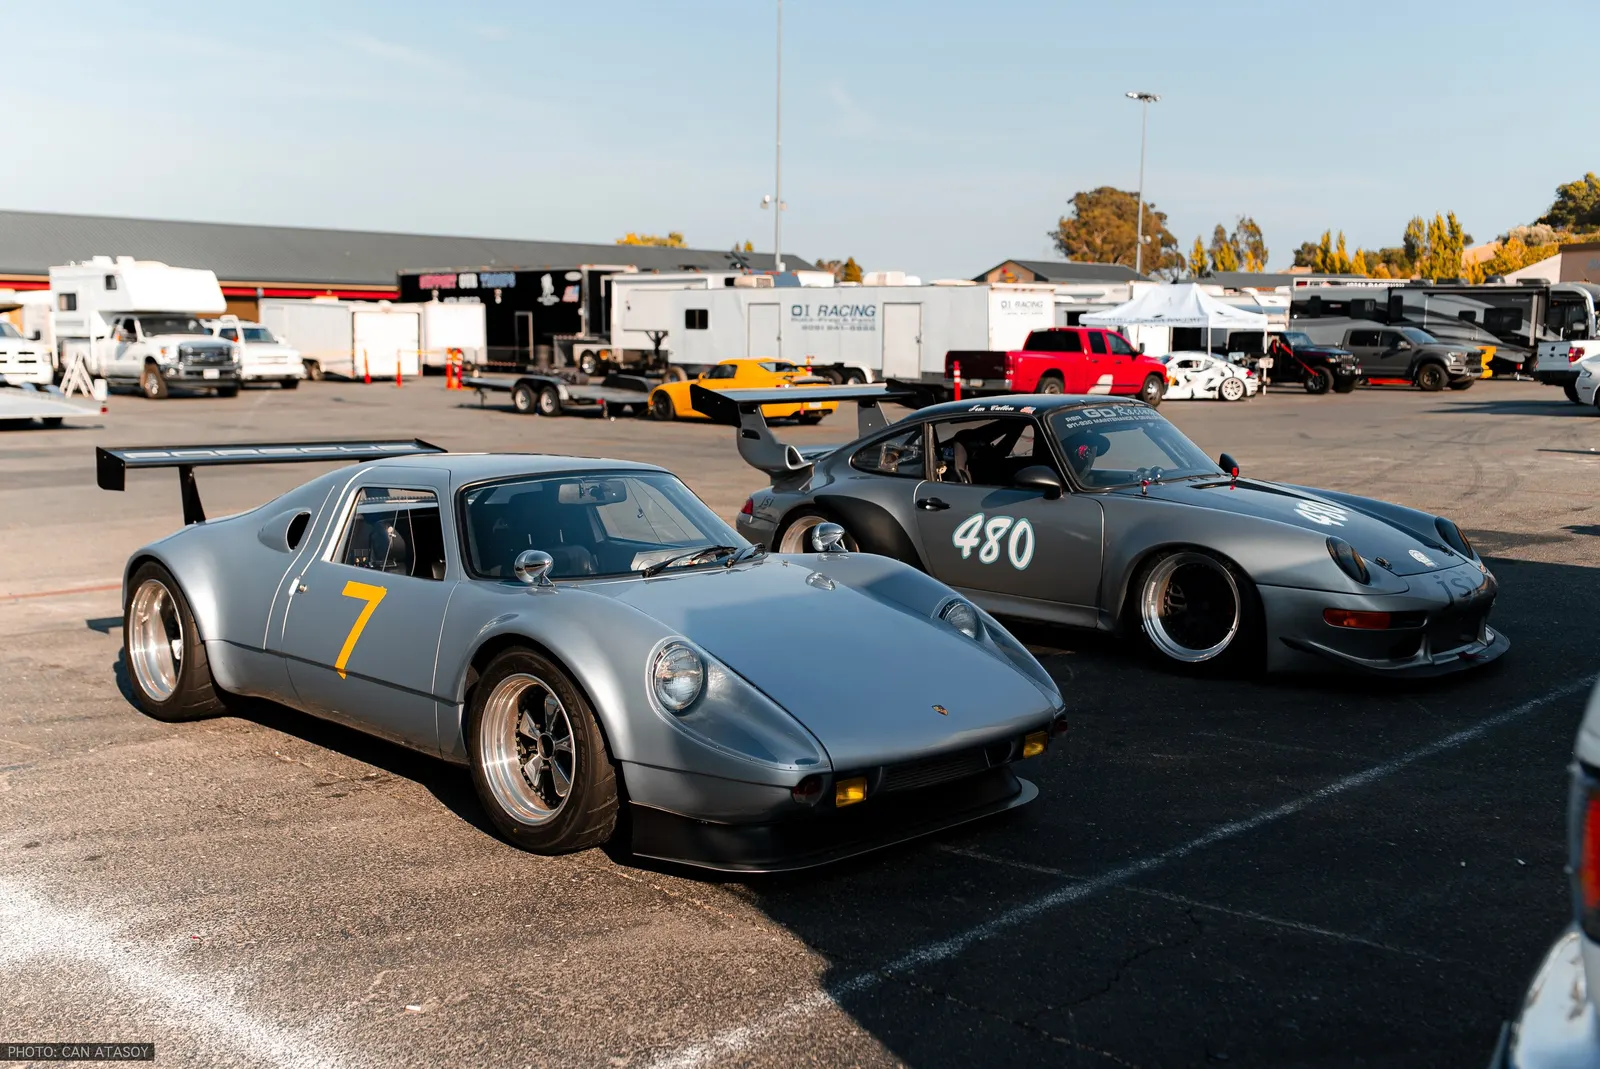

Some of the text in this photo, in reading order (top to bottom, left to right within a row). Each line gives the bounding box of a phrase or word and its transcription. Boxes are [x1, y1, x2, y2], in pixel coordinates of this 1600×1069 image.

[817, 304, 876, 317] RACING
[968, 404, 985, 412] Jim
[1082, 405, 1156, 418] GD Racing
[1093, 416, 1134, 424] MAINTENANCE
[952, 512, 1035, 570] 480
[335, 581, 387, 679] 7
